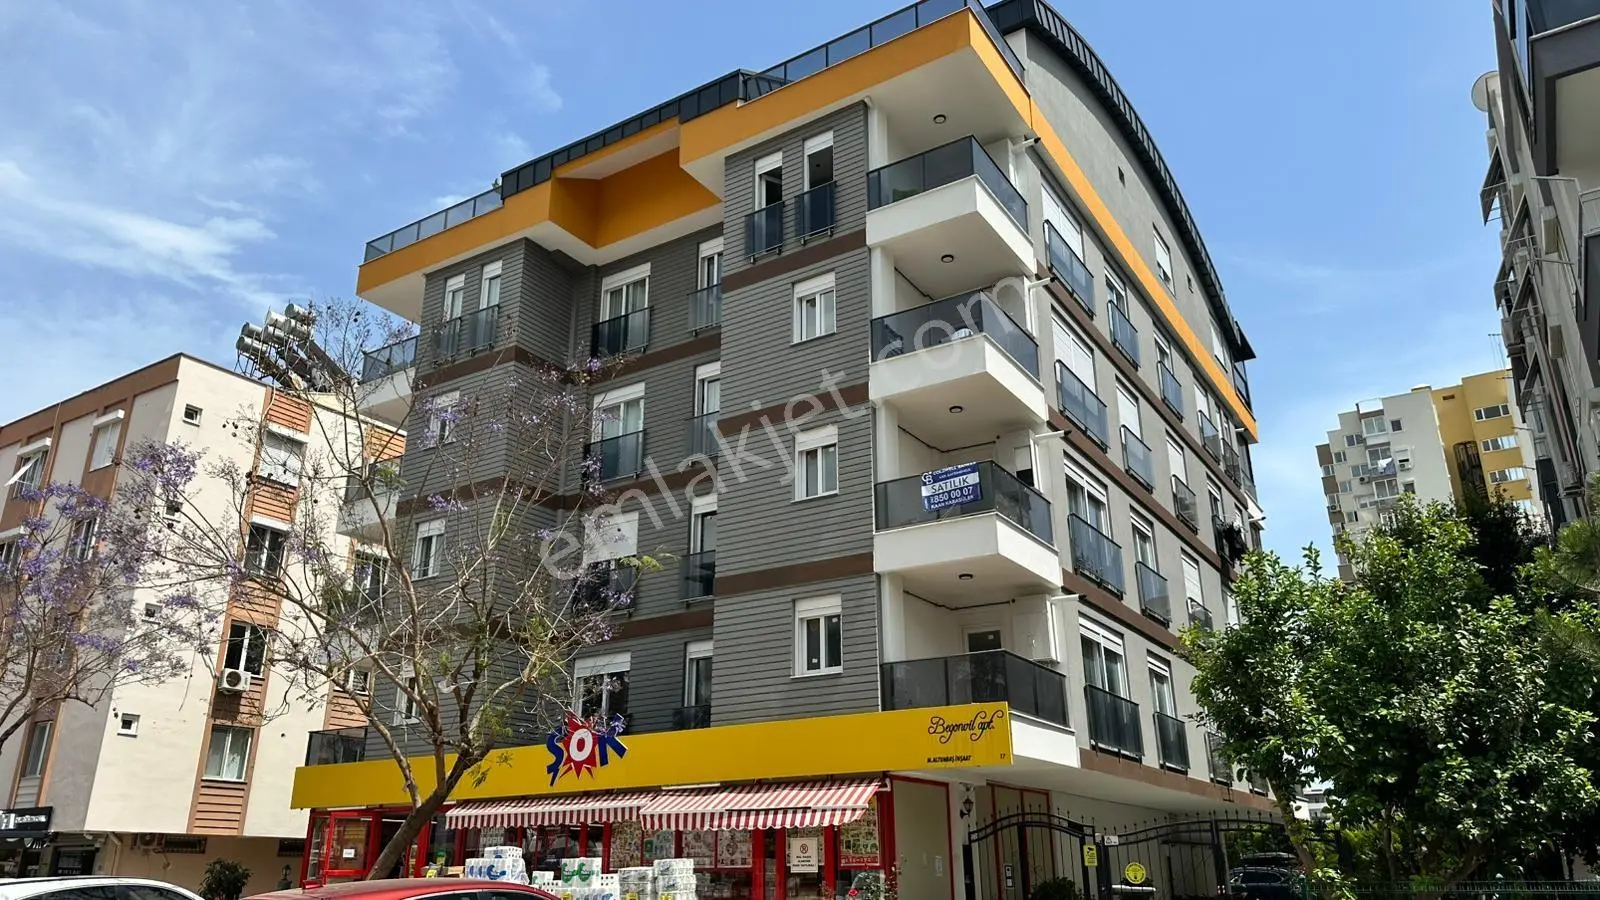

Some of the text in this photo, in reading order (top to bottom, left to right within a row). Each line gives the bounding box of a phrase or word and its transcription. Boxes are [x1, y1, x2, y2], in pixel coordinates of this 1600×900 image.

[931, 476, 970, 494] SATILIK
[950, 489, 961, 499] 00
[962, 486, 973, 496] 07
